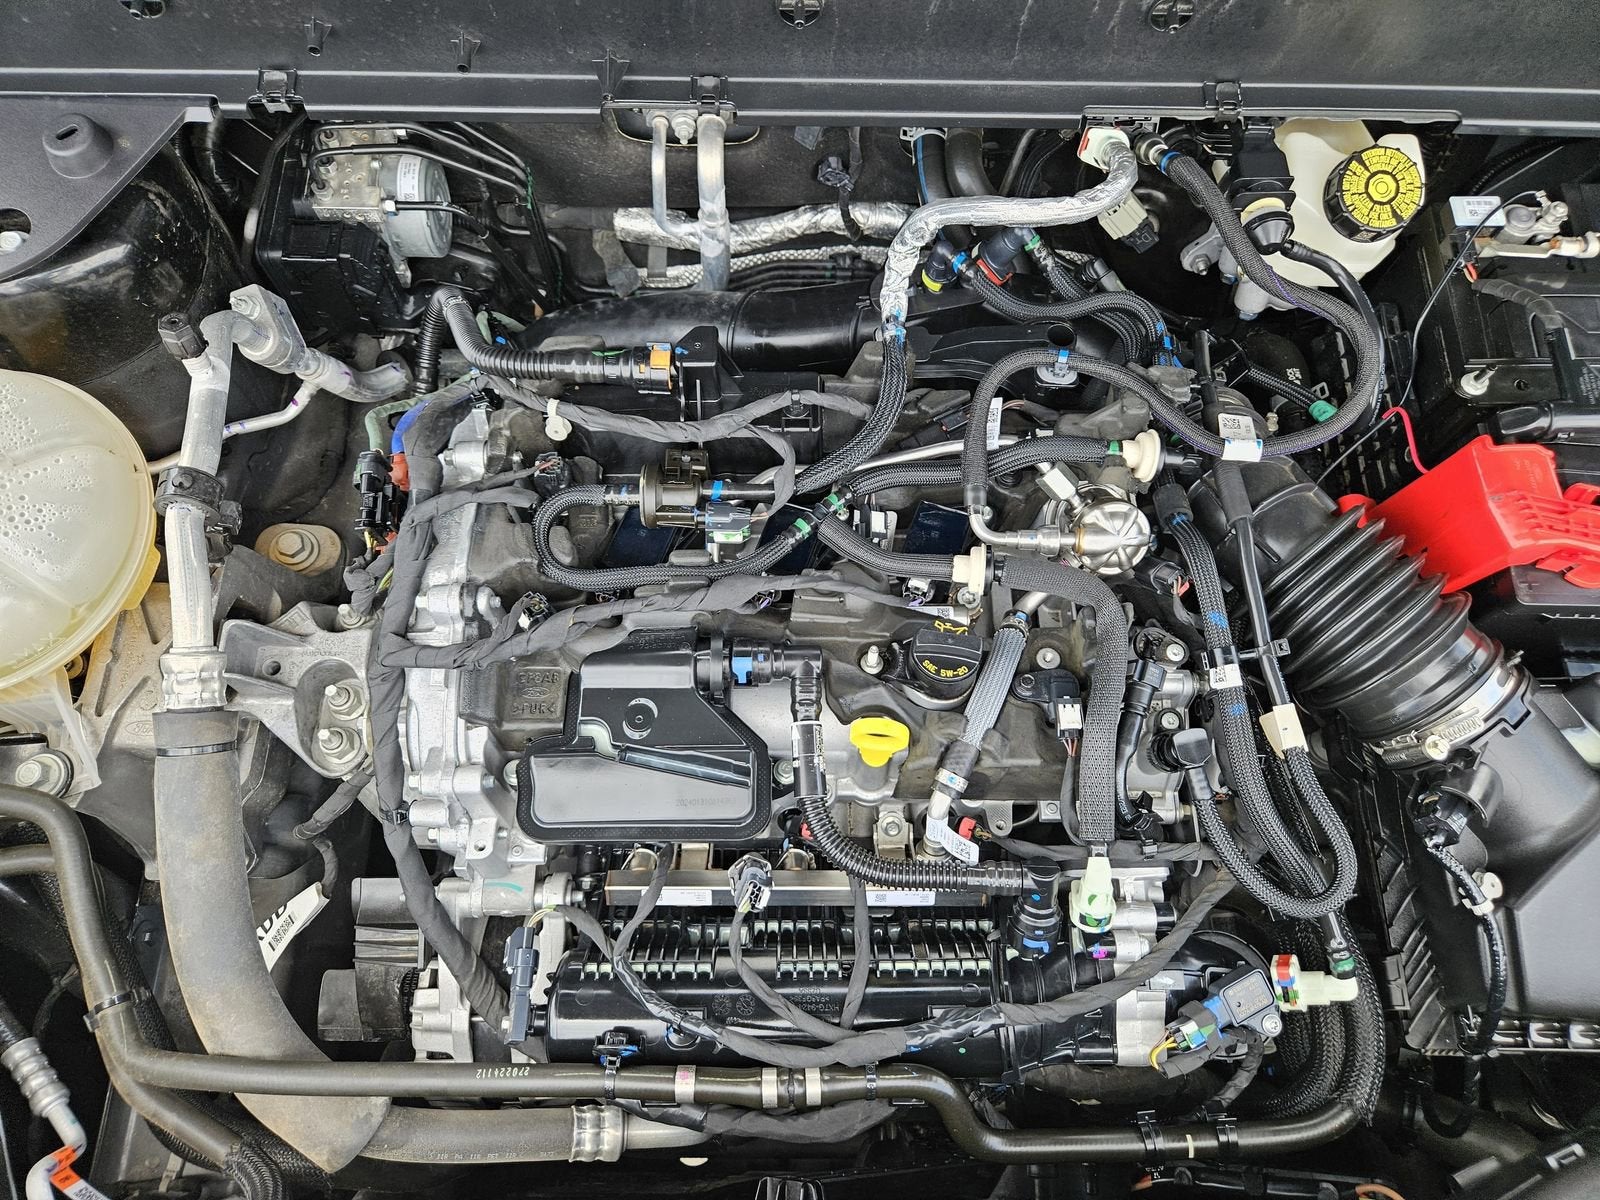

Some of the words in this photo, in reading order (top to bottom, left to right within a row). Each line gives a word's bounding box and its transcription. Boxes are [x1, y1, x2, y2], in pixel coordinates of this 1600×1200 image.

[922, 660, 938, 674] SAE
[940, 665, 969, 678] 5W-20
[476, 1066, 530, 1079] 270224112
